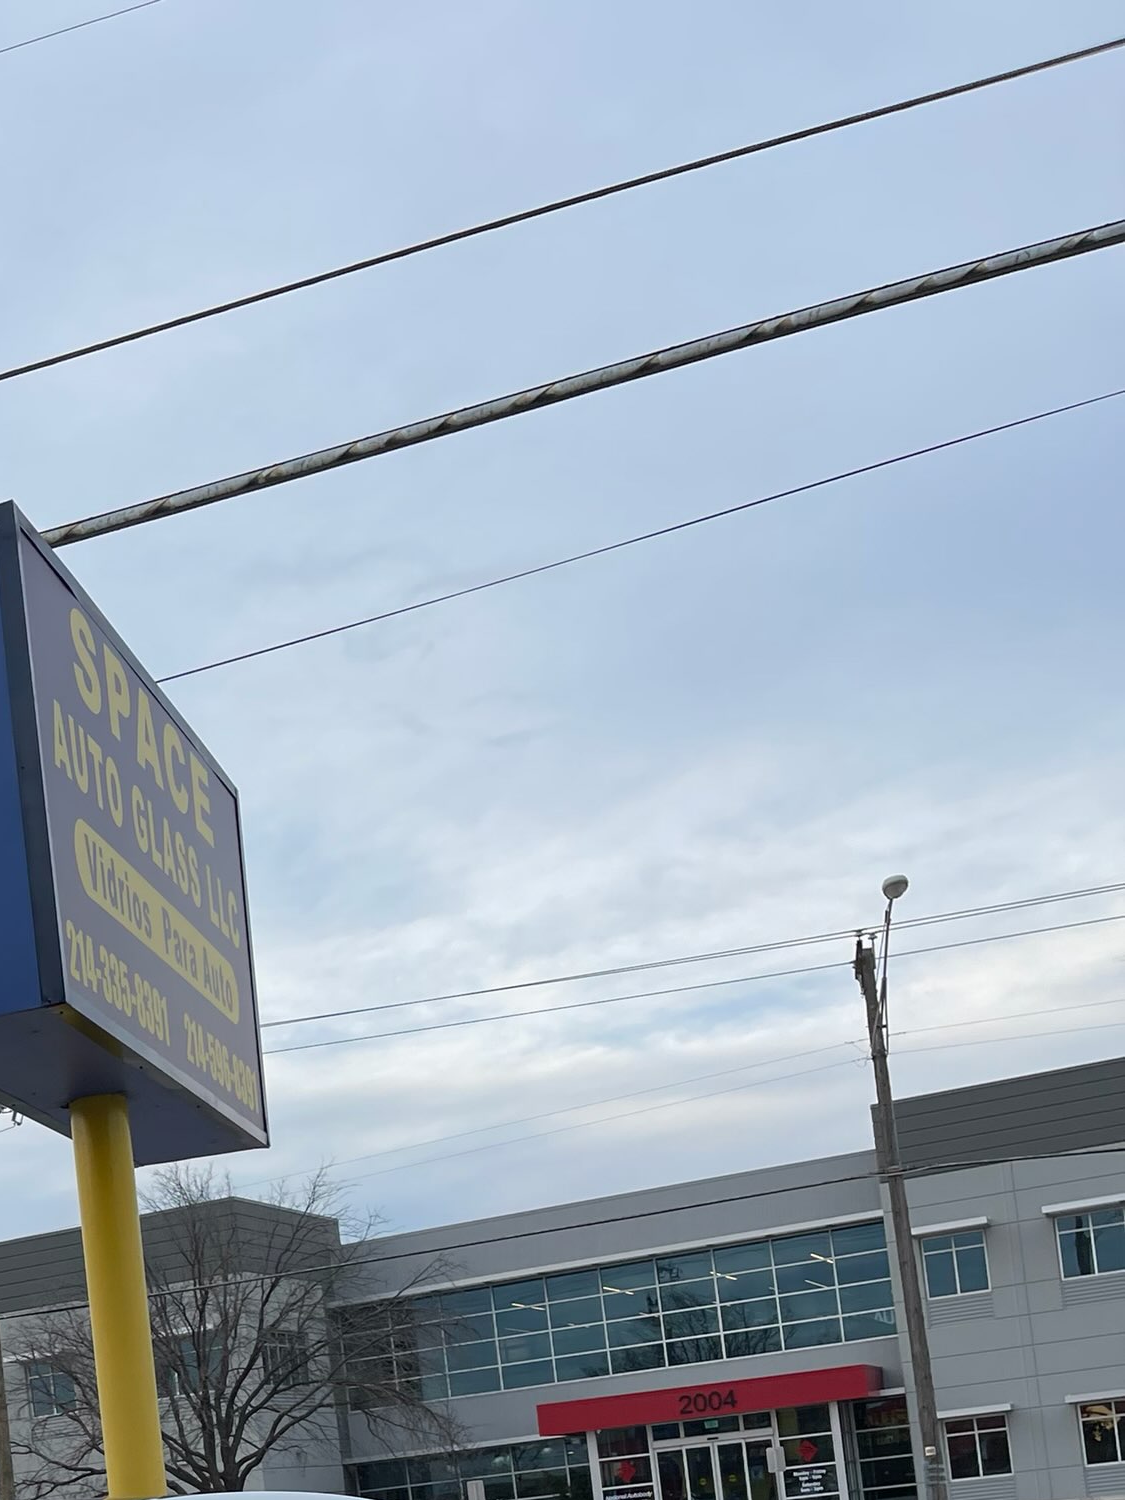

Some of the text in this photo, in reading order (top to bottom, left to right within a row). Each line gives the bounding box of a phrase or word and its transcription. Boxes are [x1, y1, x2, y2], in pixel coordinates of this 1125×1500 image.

[53, 698, 240, 948] AUTO GLASS LLC
[70, 608, 213, 848] SPACE
[66, 919, 259, 1114] 214-335-8391 214-596-8391
[84, 833, 234, 1014] Vidrios Para Auto
[679, 1390, 737, 1415] 2004
